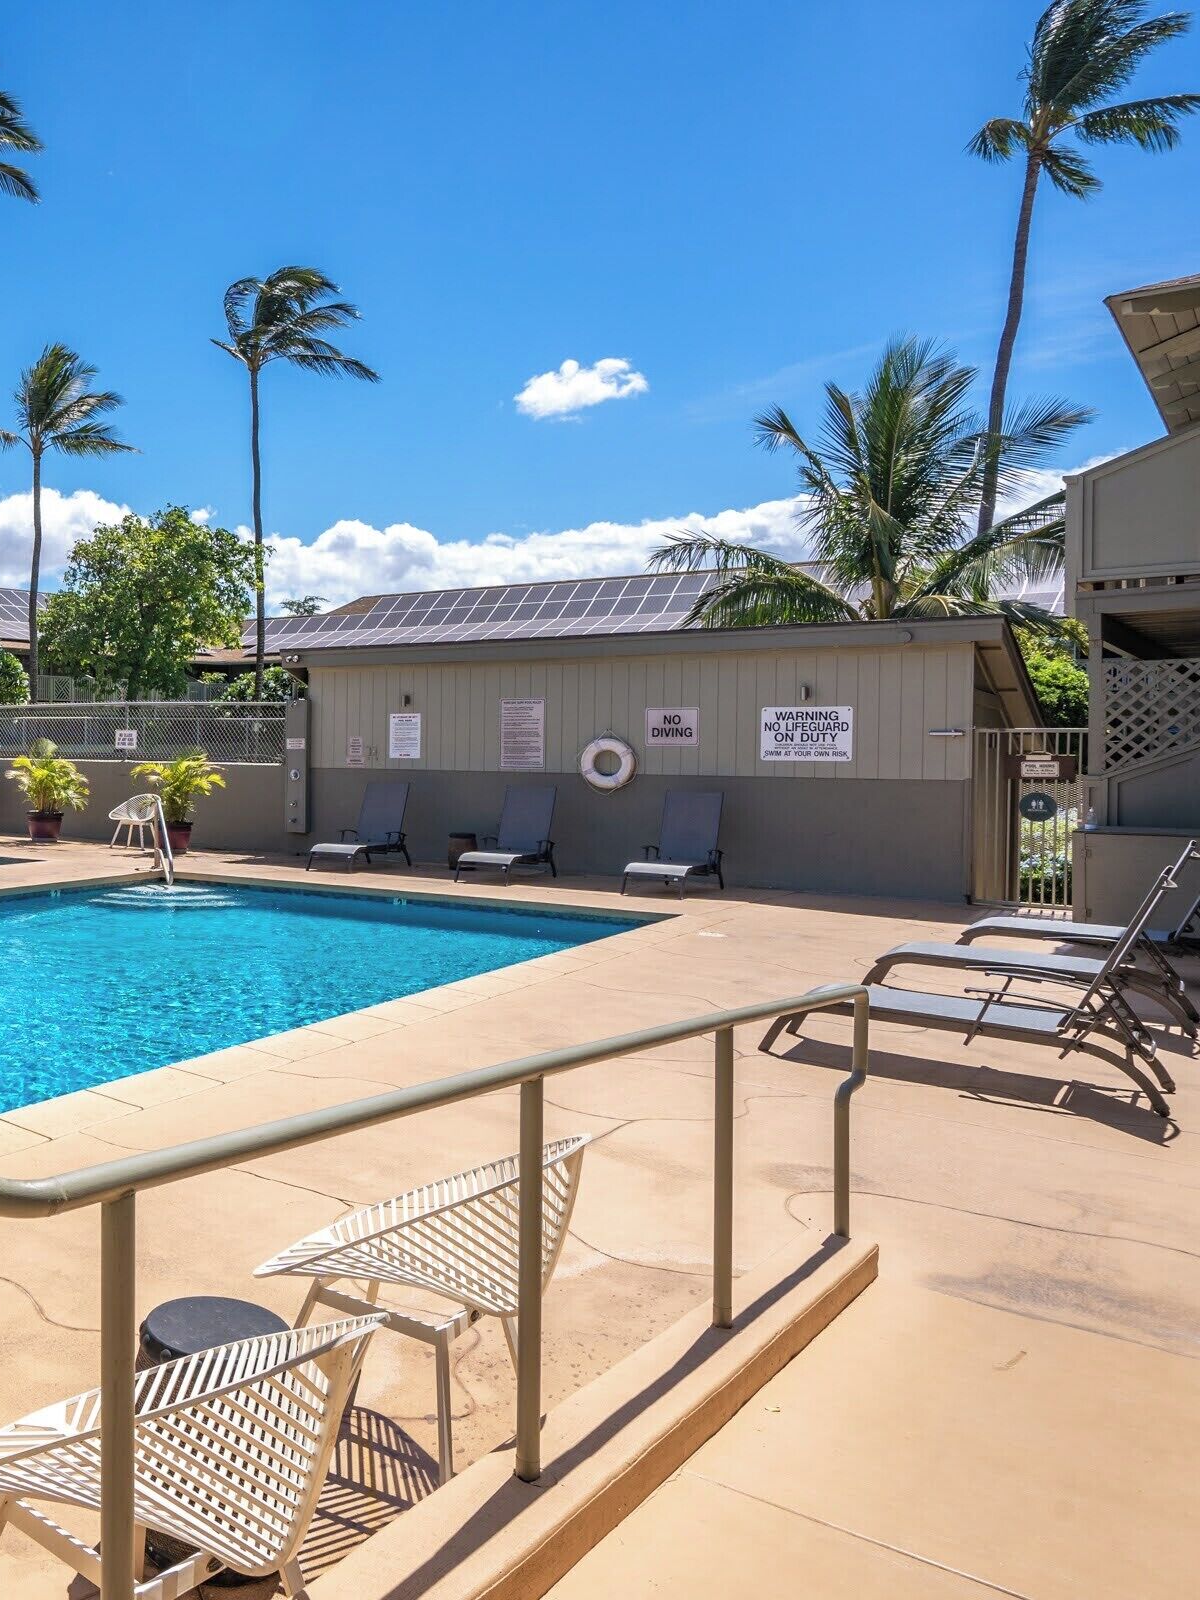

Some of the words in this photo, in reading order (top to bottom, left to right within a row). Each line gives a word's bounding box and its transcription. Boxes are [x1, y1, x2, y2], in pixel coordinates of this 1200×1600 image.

[664, 714, 681, 724] NO
[775, 711, 839, 721] WARNING
[764, 722, 780, 732] NO
[786, 722, 849, 732] LIFEGUARD
[652, 727, 692, 738] DIVING
[774, 732, 794, 742] ON
[800, 732, 838, 742] DUTY
